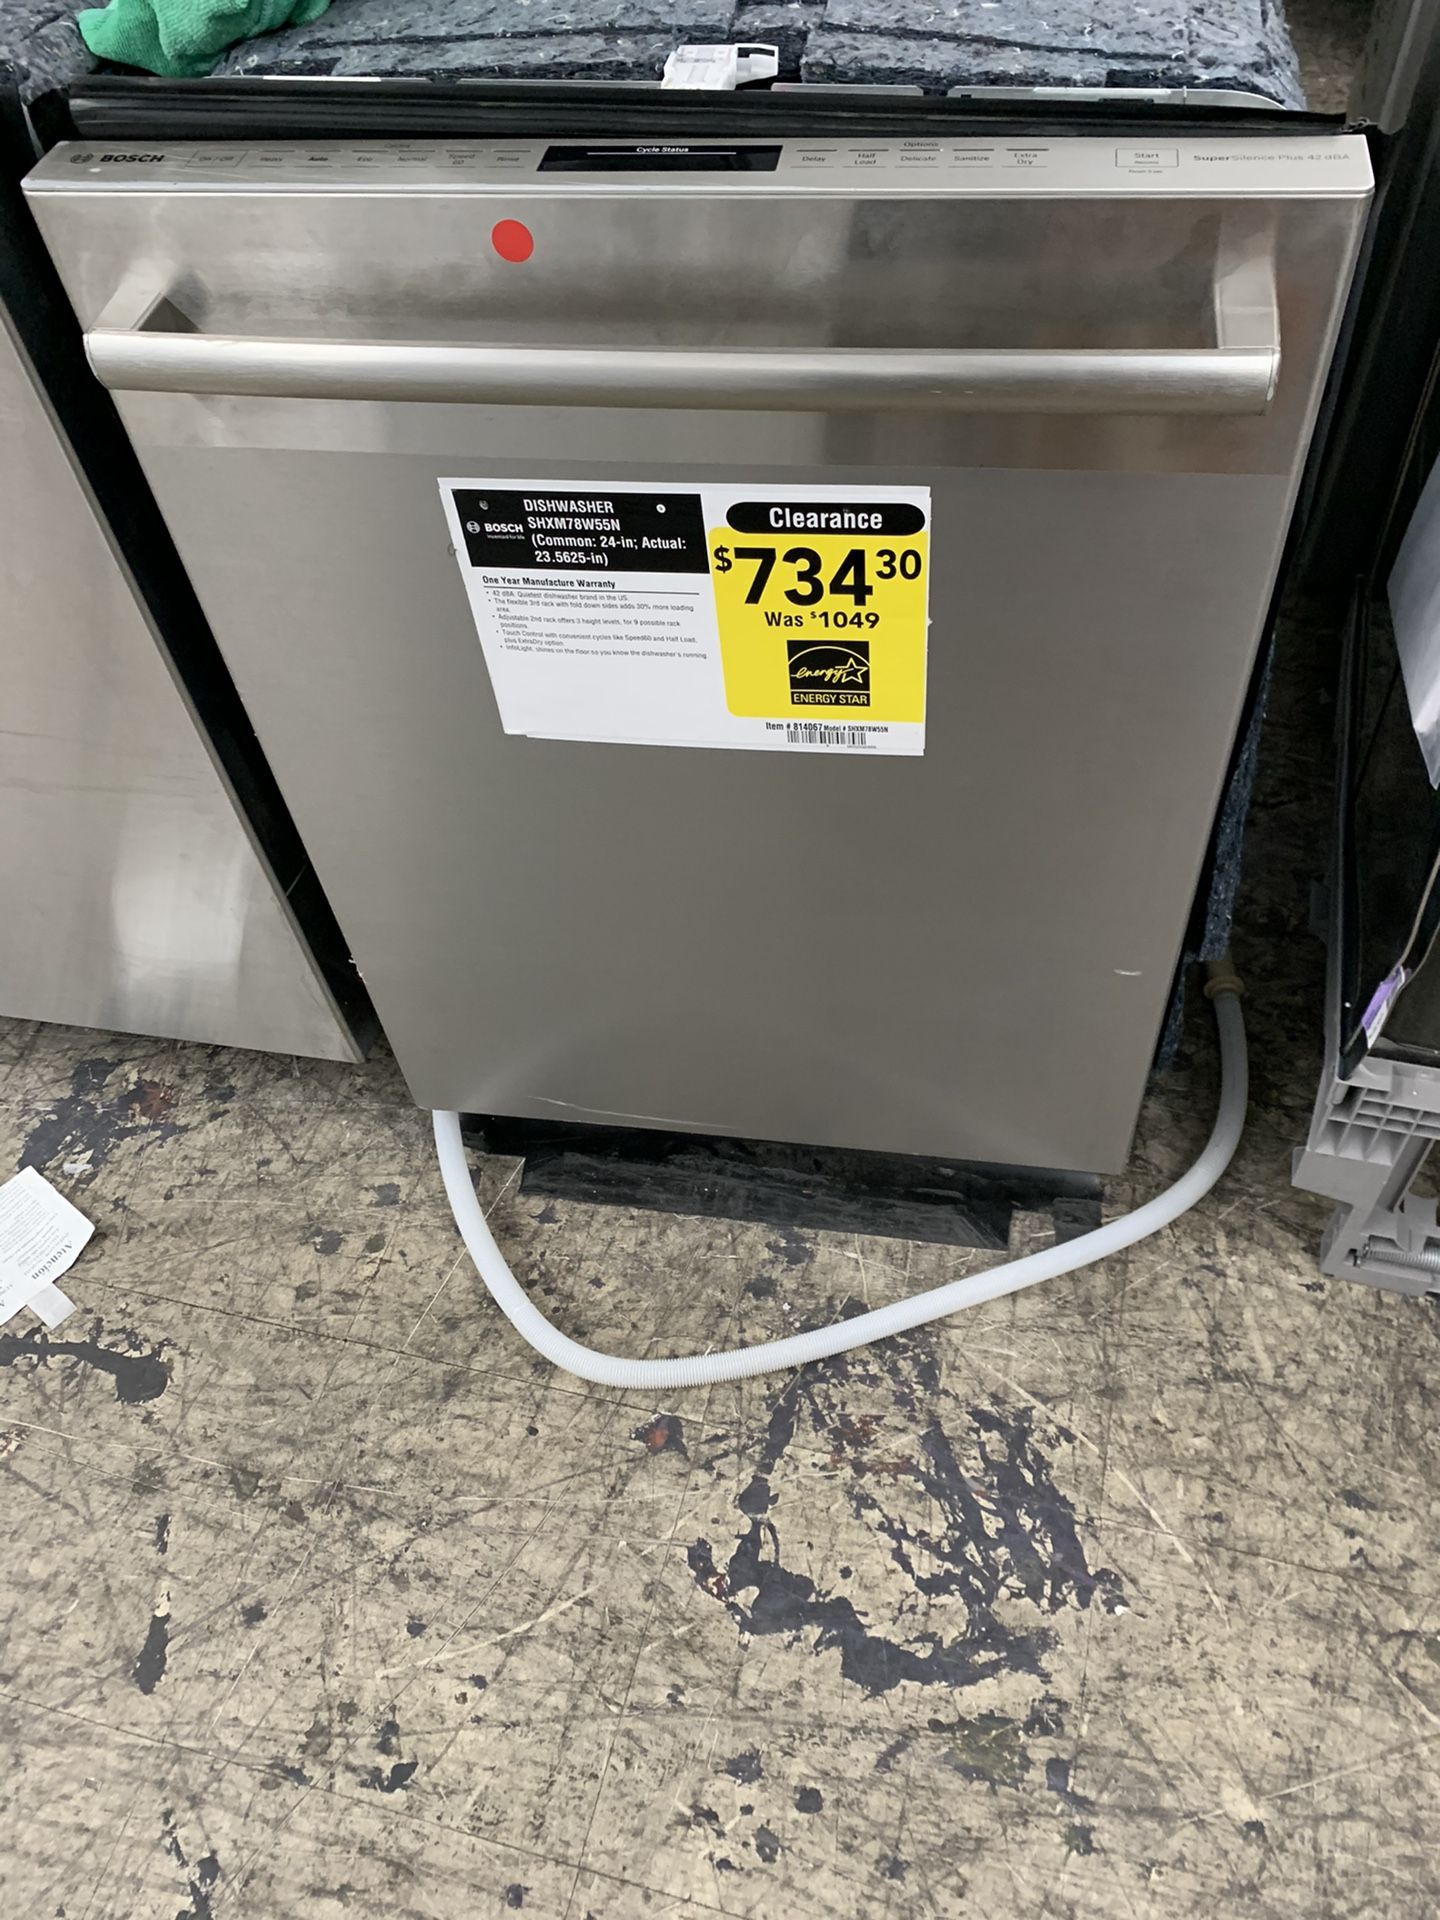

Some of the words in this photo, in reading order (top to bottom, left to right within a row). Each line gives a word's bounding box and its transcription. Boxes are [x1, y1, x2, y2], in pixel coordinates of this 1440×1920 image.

[100, 154, 165, 162] BOSCH
[801, 155, 826, 163] Delay
[523, 499, 614, 514] DISHWASHER
[527, 516, 621, 532] SHXM78W55N
[769, 507, 883, 529] Clearance
[484, 523, 524, 533] BOSCH
[531, 533, 597, 549] (Common:
[600, 536, 638, 550] 24-in;
[641, 537, 687, 550] Actual:
[534, 551, 609, 567] 23.5625-in)
[482, 576, 499, 584] One
[501, 576, 520, 585] Year
[522, 577, 575, 587] Manufacture
[577, 580, 615, 589] Warranty
[543, 592, 577, 600] dishwasher
[670, 604, 694, 612] loading
[582, 618, 601, 626] height
[640, 619, 665, 627] possible
[764, 611, 804, 627] Was
[791, 666, 845, 684] energy
[793, 693, 836, 704] ENERGY
[839, 694, 868, 705] STAR
[765, 722, 784, 730] Item
[793, 723, 822, 731] 814067
